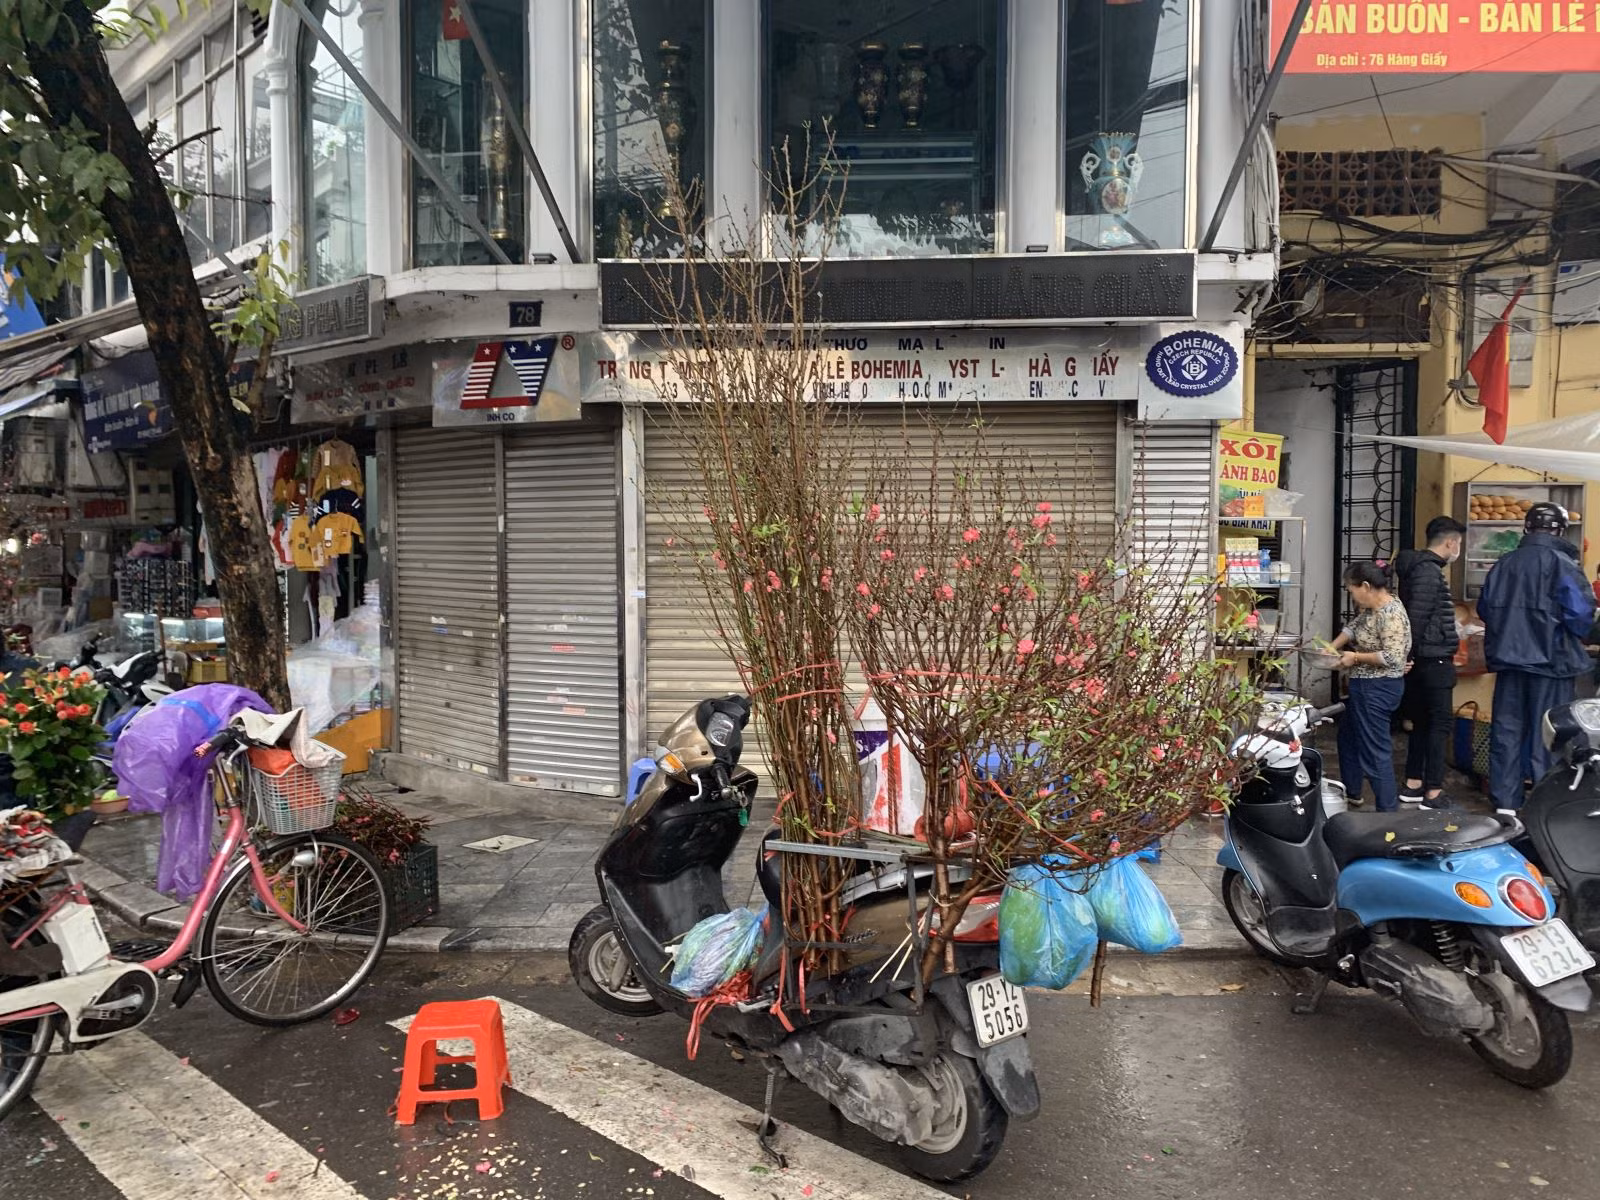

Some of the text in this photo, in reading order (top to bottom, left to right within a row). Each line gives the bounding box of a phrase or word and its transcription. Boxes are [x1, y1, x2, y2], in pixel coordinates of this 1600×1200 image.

[1366, 0, 1449, 33] BUÔN
[1458, 16, 1470, 24] -
[1316, 53, 1337, 69] Địa
[1369, 53, 1384, 66] 76
[1387, 53, 1418, 68] Hàng
[1421, 50, 1448, 67] Giấy
[1092, 256, 1187, 316] GIẤY
[515, 304, 536, 324] 78
[1163, 337, 1225, 358] BOHEMIA
[1168, 349, 1221, 365] CZECH REPUBLIC
[827, 355, 845, 380] LÊ
[851, 359, 923, 380] BOHEMIA
[1180, 382, 1209, 390] CRYSTAL
[1219, 437, 1278, 461] XÔI
[1251, 466, 1277, 484] BAO
[1529, 945, 1584, 980] 6234
[983, 1003, 1024, 1040] 5056
